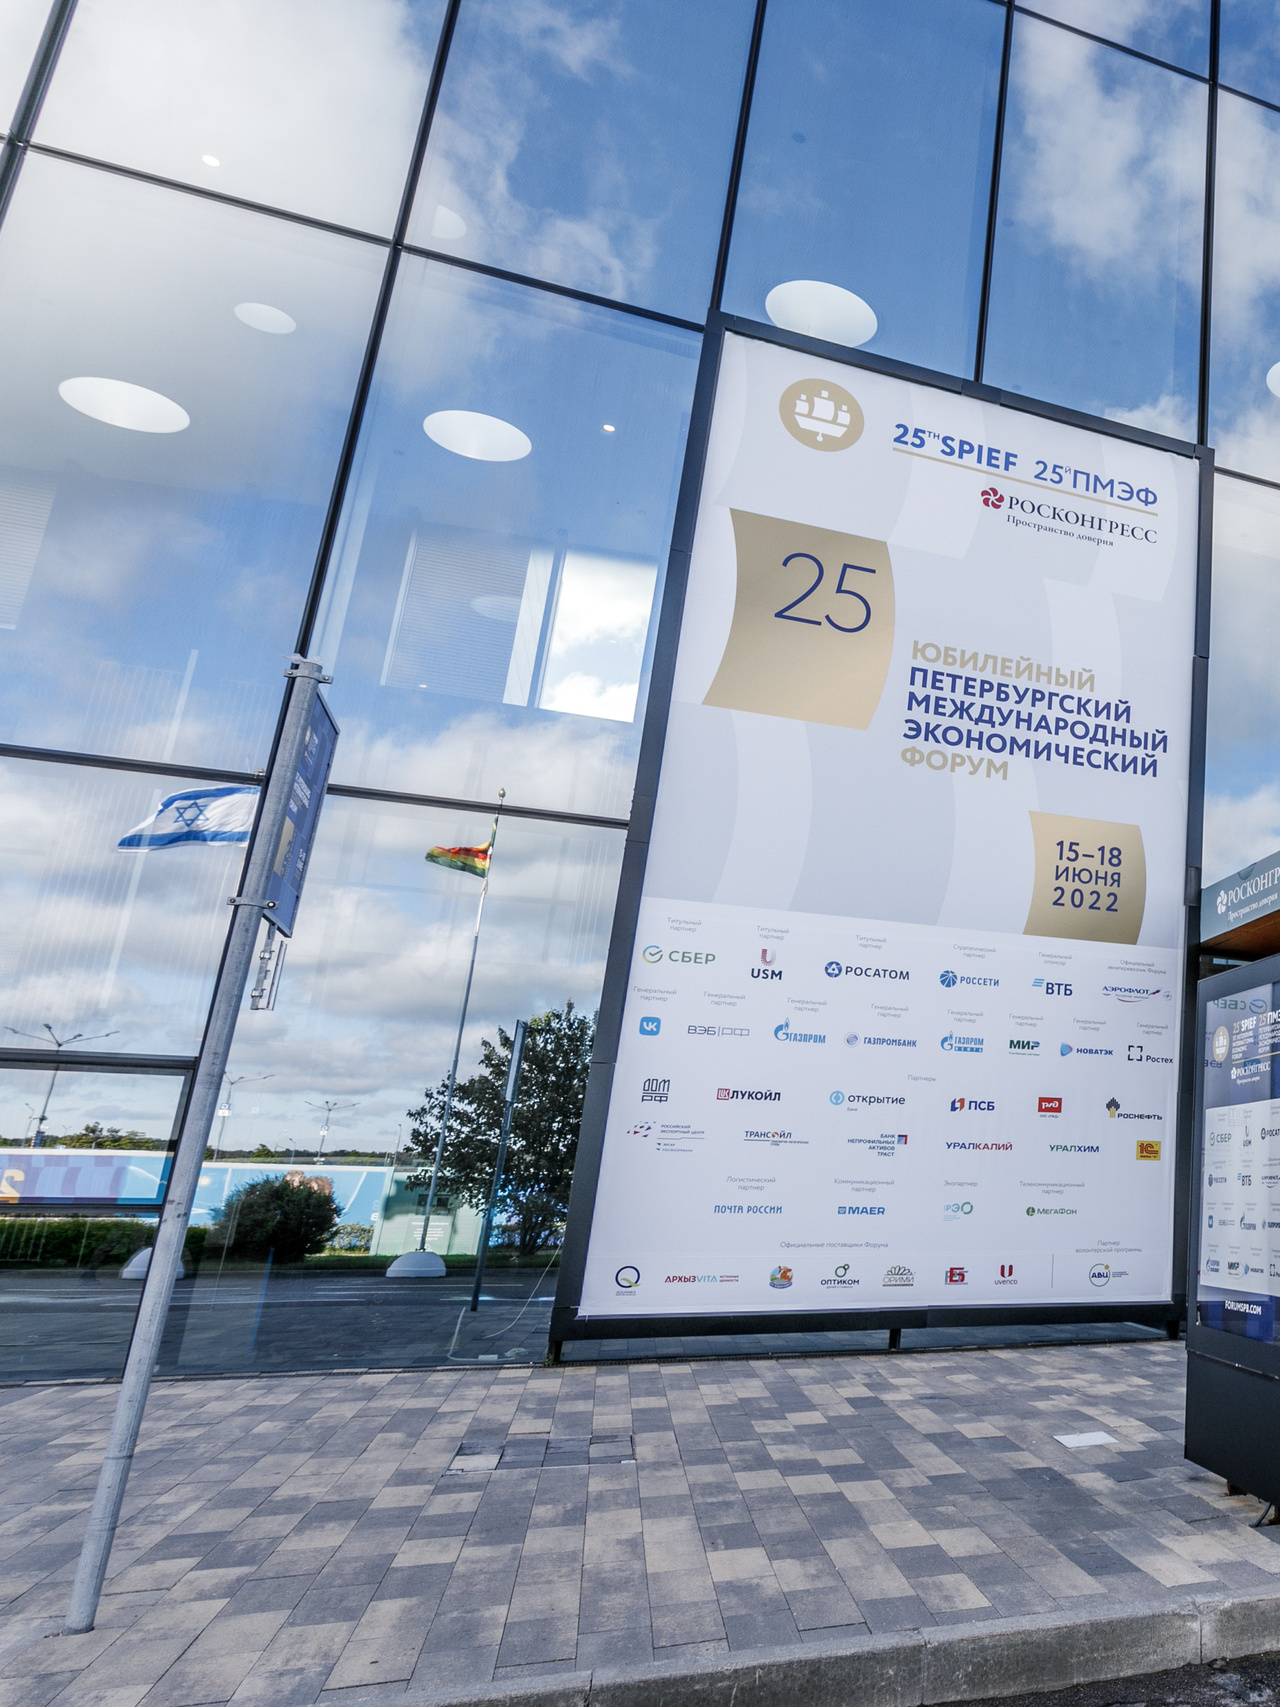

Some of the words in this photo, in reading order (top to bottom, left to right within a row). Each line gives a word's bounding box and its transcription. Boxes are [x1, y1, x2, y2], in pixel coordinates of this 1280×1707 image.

[940, 435, 1018, 471] SPIEF
[1072, 469, 1158, 506] ПМЭФ
[1008, 495, 1158, 544] РОСКОНГРЕСС
[1006, 514, 1075, 538] Пространство
[1075, 532, 1114, 547] доверия
[774, 552, 876, 633] 25
[911, 640, 1095, 692] ЮБИЛЕЙНЫЙ
[909, 666, 1132, 723] ПЕТЕРБУРГСКИЙ
[906, 691, 1168, 753] МЕЖДУНАРОДНЫЙ
[902, 718, 1158, 777] ЭКОНОМИЧЕСКИЙ
[901, 746, 1008, 780] ФОРУМ
[1054, 865, 1121, 887] ИЮНЯ
[1052, 886, 1118, 912] 2022
[669, 950, 716, 965] СБЕР
[751, 968, 783, 981] USM
[845, 966, 910, 980] РОСАТОМ
[960, 976, 999, 987] РОССЕТИ
[1045, 982, 1073, 997] ВТБ
[1102, 985, 1150, 995] АЭРОФЛОТ
[1241, 1016, 1257, 1032] SPIEF
[788, 1031, 826, 1044] ГАЗПРОМ
[863, 1036, 918, 1048] ГАЗПРОМБАНК
[954, 1036, 984, 1046] ГАЗПРОМ
[1009, 1039, 1040, 1050] МИР
[1076, 1047, 1114, 1056] НОВАТЭК
[1145, 1055, 1174, 1064] Ростех
[907, 1074, 937, 1082] Партнеры
[643, 1078, 670, 1092] ДОМ
[730, 1089, 781, 1102] ЛУКОЙЛ
[848, 1094, 906, 1106] открытие
[968, 1100, 995, 1111] ПСБ
[1216, 1132, 1232, 1143] СБЕР
[945, 1141, 1013, 1151] УРАЛКАЛИЙ
[1049, 1144, 1100, 1153] УРАЛХИМ
[726, 1176, 776, 1184] Логистический
[1241, 1175, 1252, 1186] ВТБ
[714, 1205, 743, 1214] ПОЧТА
[747, 1205, 782, 1214] РОССИИ
[848, 1206, 886, 1215] MAER
[780, 1241, 825, 1249] Официальные
[826, 1241, 863, 1249] поставщики
[864, 1241, 889, 1249] Форума
[664, 1275, 696, 1283] АРХЫЗ
[696, 1275, 718, 1283] VITA
[882, 1276, 915, 1284] ОРИМИ
[1225, 1300, 1262, 1315] FORUMSPB.COM
